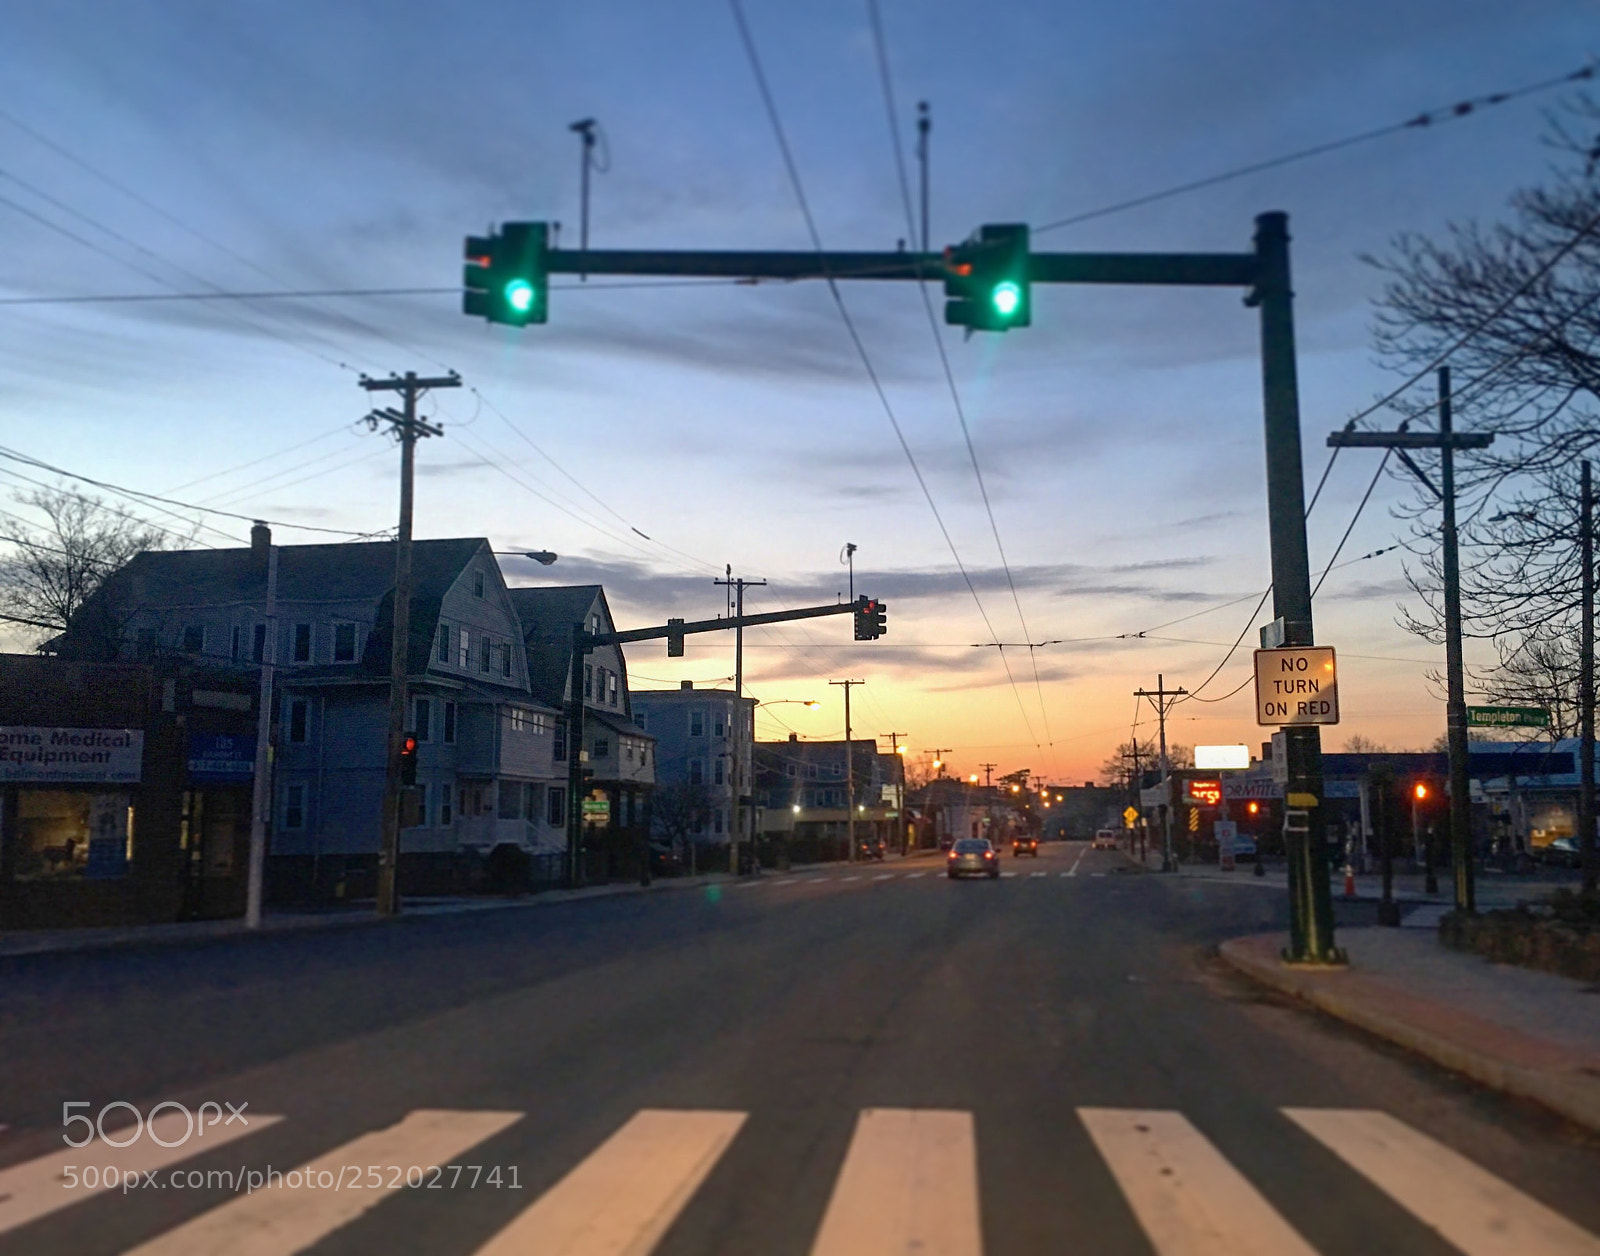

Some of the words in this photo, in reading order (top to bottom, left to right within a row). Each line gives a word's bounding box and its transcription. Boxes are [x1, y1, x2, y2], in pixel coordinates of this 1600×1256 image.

[1281, 657, 1308, 672] NO
[1273, 679, 1319, 694] TURN
[1265, 702, 1287, 716] ON
[1297, 701, 1330, 716] RED
[1470, 709, 1521, 724] Templeton
[50, 731, 131, 748] Medical
[0, 746, 112, 766] Equipment
